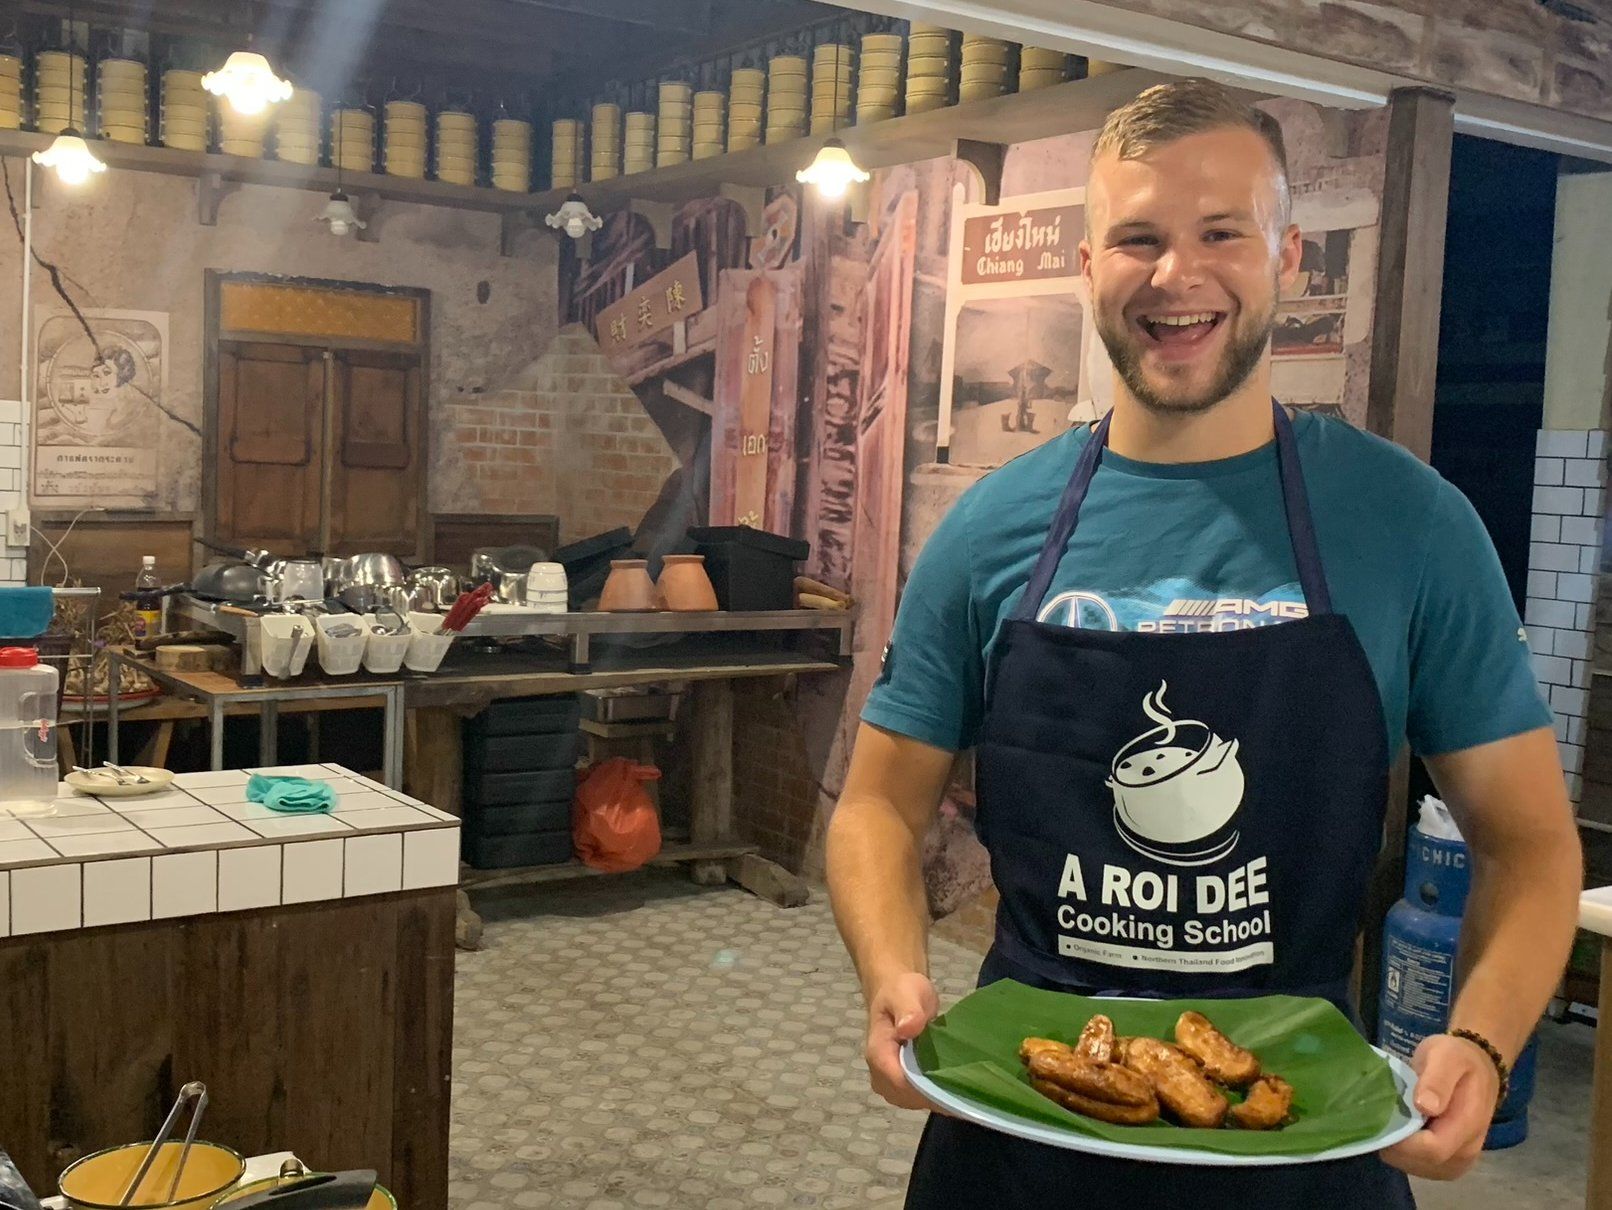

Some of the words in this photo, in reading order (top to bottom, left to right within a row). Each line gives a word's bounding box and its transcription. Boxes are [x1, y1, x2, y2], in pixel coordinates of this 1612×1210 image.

[976, 256, 1024, 276] Chiang
[1037, 250, 1065, 270] Mai
[1057, 853, 1087, 901] A
[1101, 863, 1178, 913] ROI
[1196, 856, 1270, 914] DEE
[1057, 904, 1174, 948] Cooking
[1184, 909, 1271, 944] School
[1179, 957, 1213, 966] Thailand
[1215, 957, 1234, 966] Food
